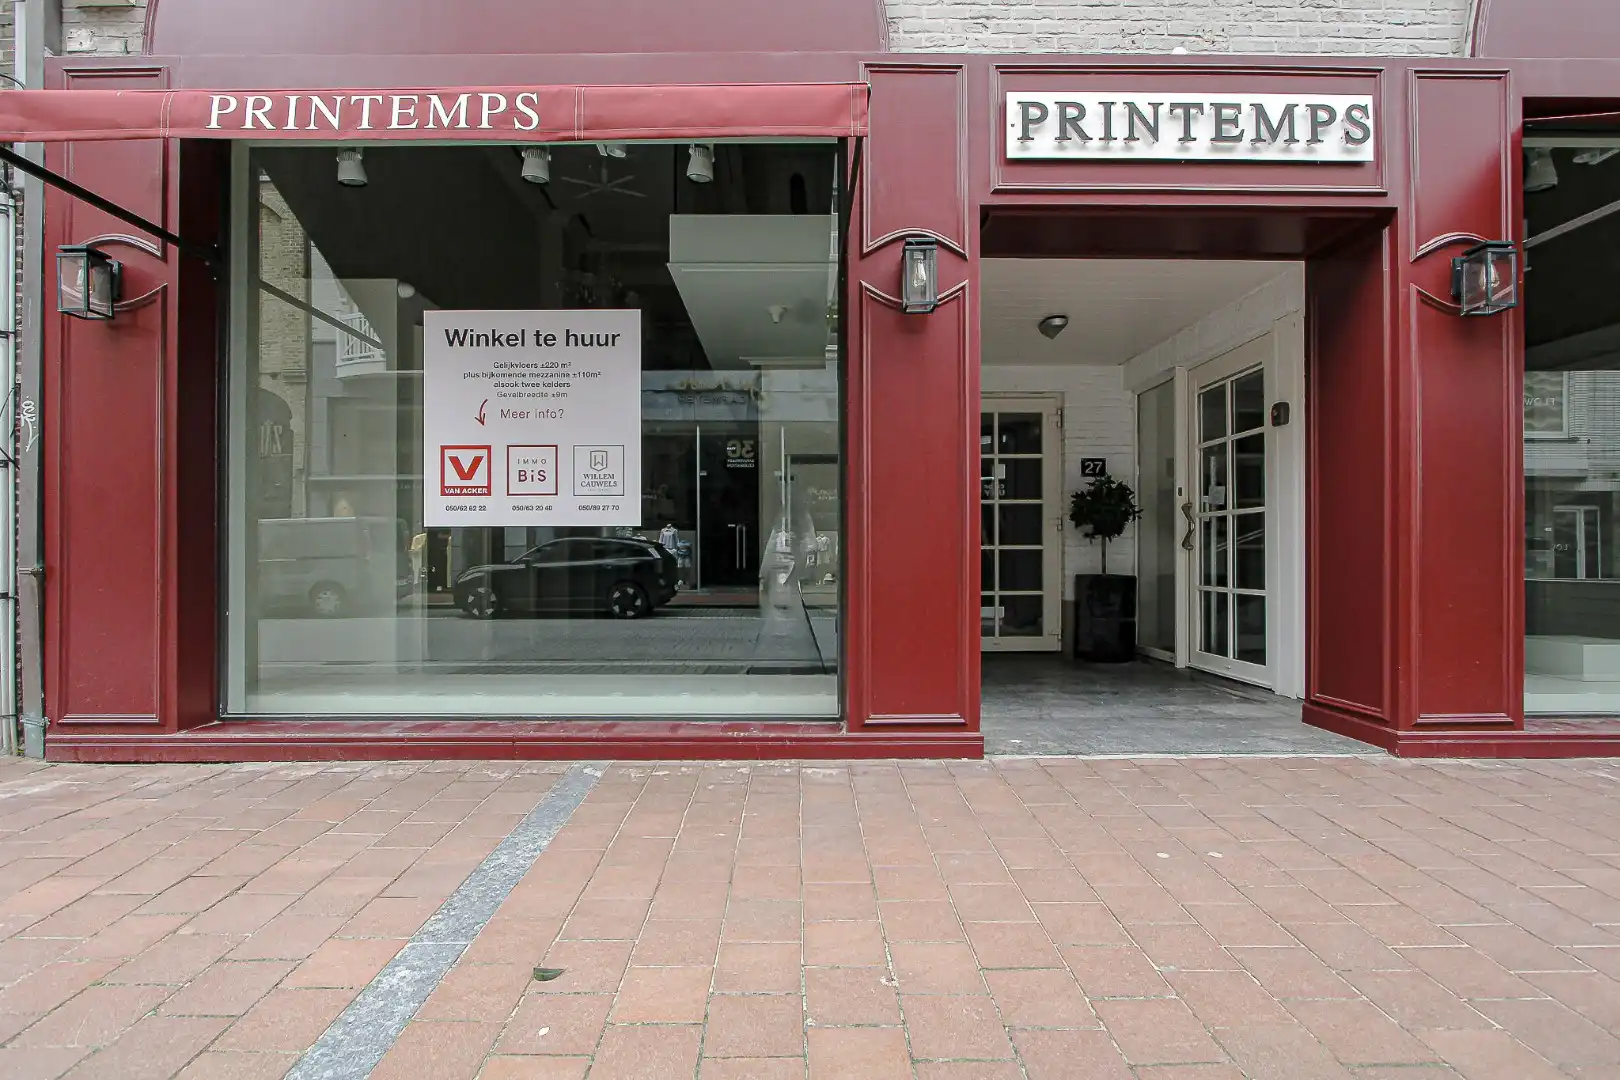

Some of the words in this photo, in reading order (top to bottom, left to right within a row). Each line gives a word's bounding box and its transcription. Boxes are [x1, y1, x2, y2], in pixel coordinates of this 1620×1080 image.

[206, 92, 541, 131] PRINTEMPS
[1018, 101, 1373, 146] PRINTEMPS
[445, 328, 525, 347] Winkel
[533, 329, 557, 347] te
[565, 328, 621, 347] huur
[493, 361, 539, 370] Gelijkvloers
[463, 372, 480, 380] plus
[481, 372, 527, 380] bijkomende
[500, 408, 531, 419] Meer
[535, 408, 564, 419] info?
[1084, 461, 1103, 474] 27
[518, 469, 547, 483] BiS
[580, 480, 618, 488] CAUWELS
[445, 504, 468, 512] 050/62
[469, 504, 477, 512] 62
[478, 504, 487, 512] 22
[512, 504, 534, 512] 050/63
[535, 504, 544, 512] 20
[545, 504, 553, 512] 40
[601, 504, 610, 512] 27
[611, 504, 620, 512] 70
